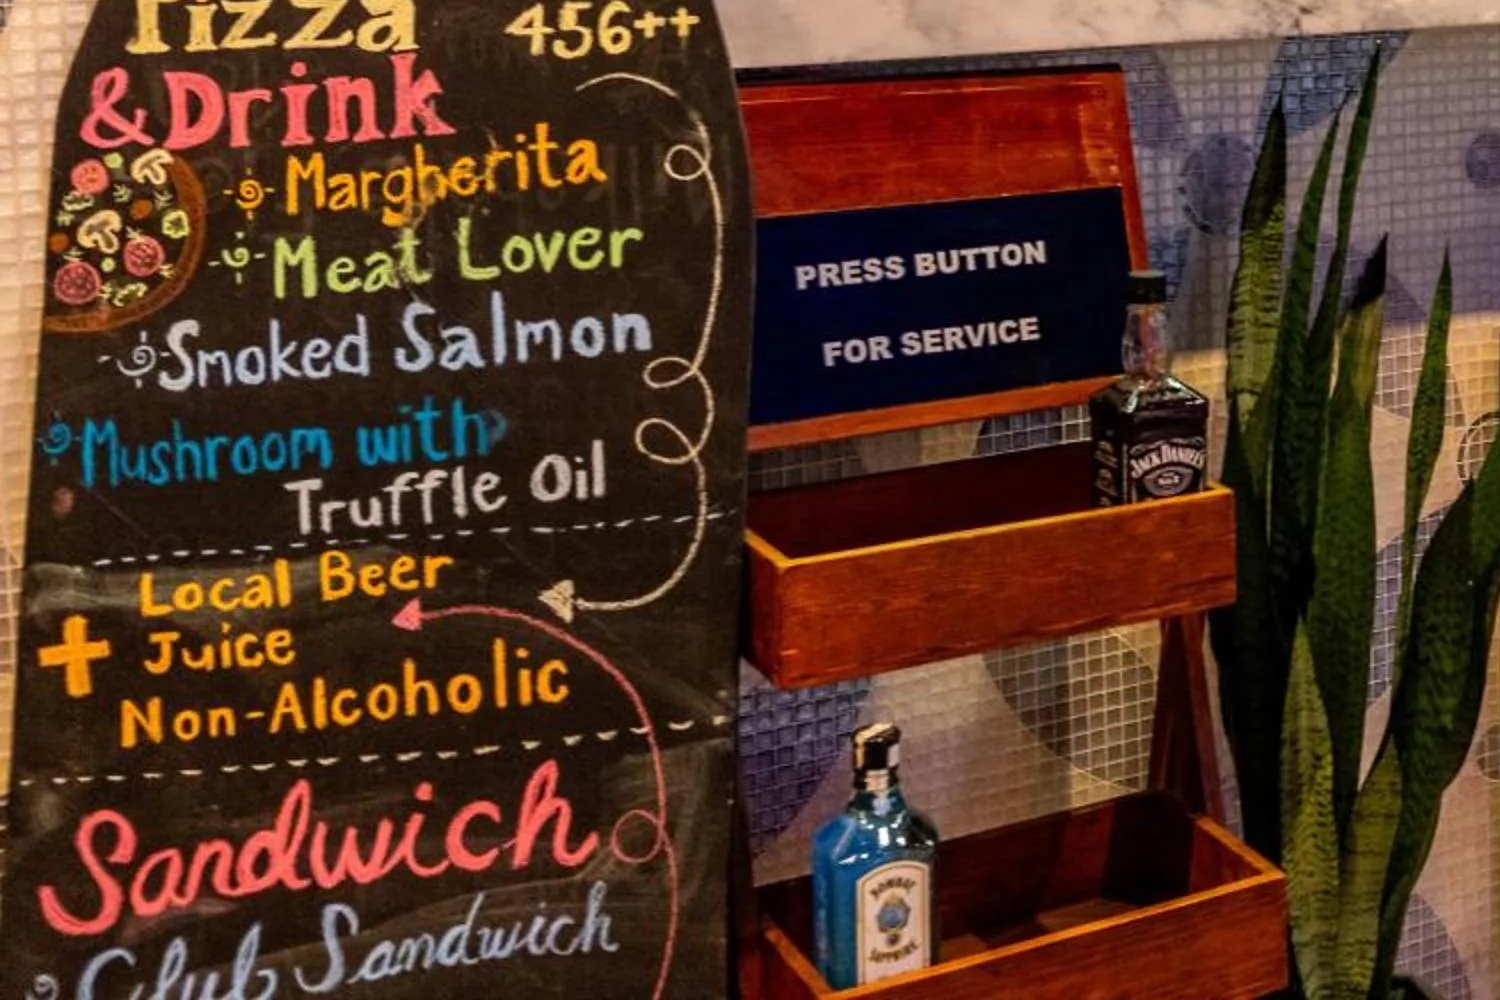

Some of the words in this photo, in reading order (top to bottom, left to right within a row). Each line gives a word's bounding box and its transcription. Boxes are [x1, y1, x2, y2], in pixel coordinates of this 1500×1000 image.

[505, 1, 698, 59] 456++
[286, 123, 607, 226] Margherita
[272, 226, 431, 299] Meat
[457, 217, 643, 279] Lover
[795, 256, 904, 290] PRESS
[914, 240, 1046, 277] BUTTON
[159, 314, 370, 392] Smoked
[395, 292, 653, 371] Salmon
[822, 336, 893, 367] FOR
[901, 317, 1040, 356] SERVICE
[80, 417, 331, 489] Mushroom
[356, 399, 498, 467] with
[284, 466, 507, 534] Truffle
[529, 440, 606, 502] Oil
[1130, 449, 1161, 480] JACK
[139, 560, 292, 617] Local
[320, 550, 453, 600] Beer
[144, 622, 295, 674] Juice
[120, 638, 570, 748] Non-Alcoholic
[39, 760, 598, 936] Sandwich
[77, 922, 278, 1000] Club
[295, 880, 618, 993] Sandwich
